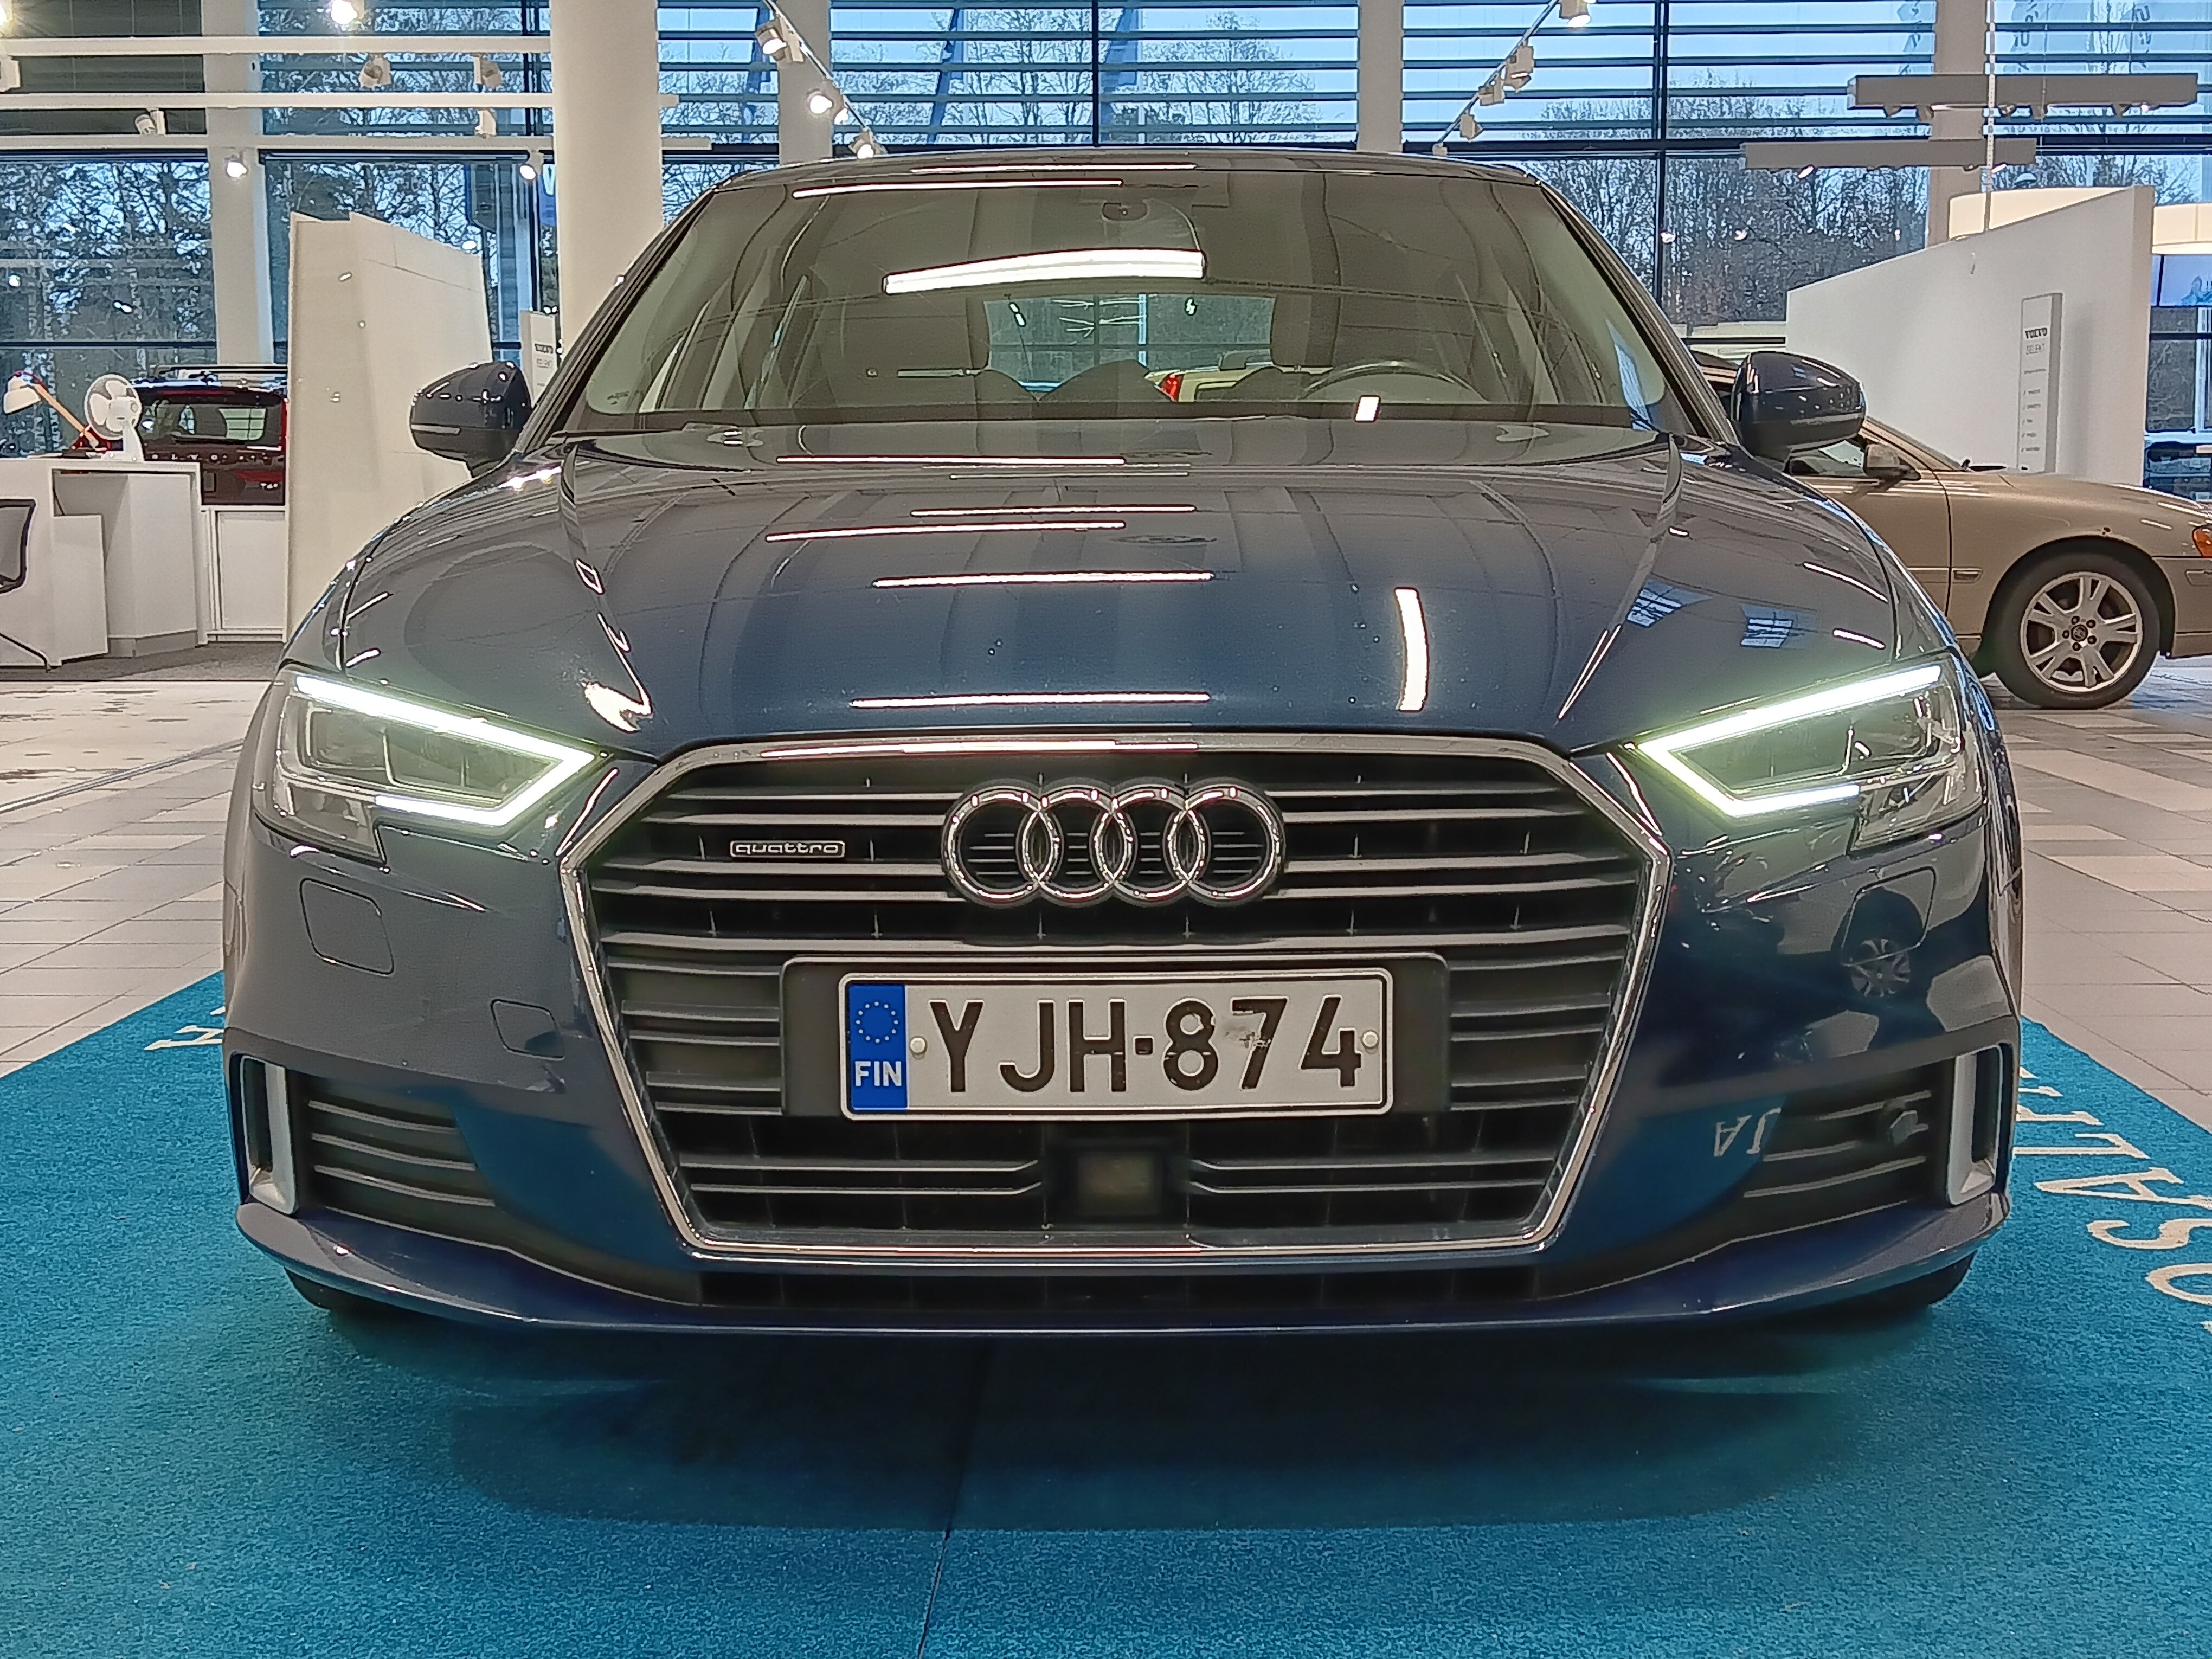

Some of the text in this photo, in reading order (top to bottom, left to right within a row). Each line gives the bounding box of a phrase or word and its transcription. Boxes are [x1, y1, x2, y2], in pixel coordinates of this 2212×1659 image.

[735, 843, 838, 854] quattro
[929, 995, 1362, 1093] YJH-874
[855, 1060, 902, 1086] FIN
